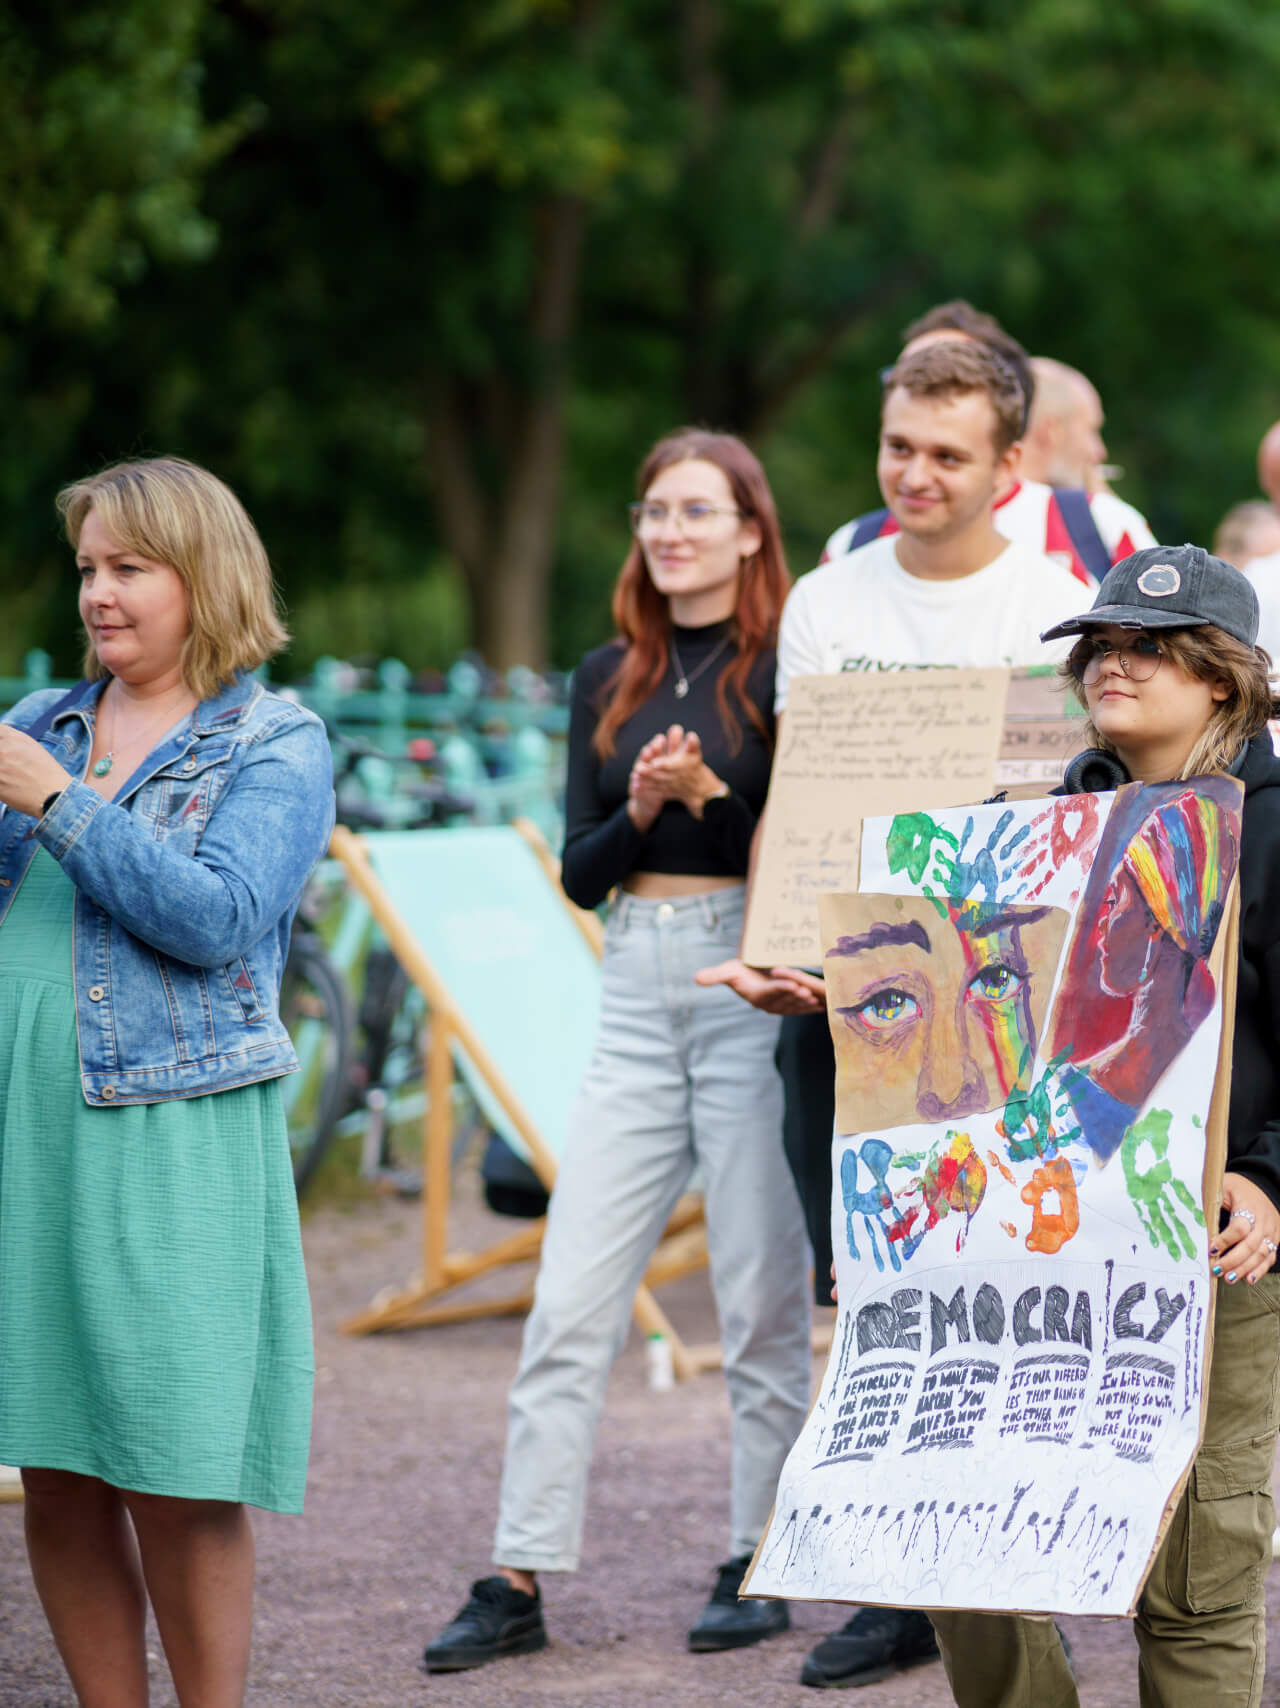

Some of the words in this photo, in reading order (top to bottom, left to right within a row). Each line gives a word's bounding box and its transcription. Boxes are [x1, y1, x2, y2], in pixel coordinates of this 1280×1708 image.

[857, 1281, 1187, 1358] DEMOCRACY
[922, 1374, 937, 1393] TO
[1009, 1368, 1032, 1390] IT'S
[1032, 1369, 1051, 1385] OUR
[1099, 1372, 1118, 1391] IN
[1142, 1376, 1156, 1388] WE
[1025, 1389, 1052, 1405] THAT
[1142, 1393, 1154, 1407] SO
[1002, 1407, 1052, 1424] TOGETHER
[1057, 1405, 1077, 1419] NOT
[1127, 1412, 1163, 1428] VOTING
[906, 1412, 942, 1443] HAVE
[999, 1424, 1019, 1438] THE
[1023, 1421, 1052, 1433] OTHER
[1053, 1421, 1069, 1431] WAY
[1087, 1422, 1120, 1438] THERE
[1120, 1427, 1138, 1440] ARE
[1139, 1431, 1153, 1444] NO
[826, 1436, 853, 1457] EAT
[855, 1429, 891, 1449] LIONS
